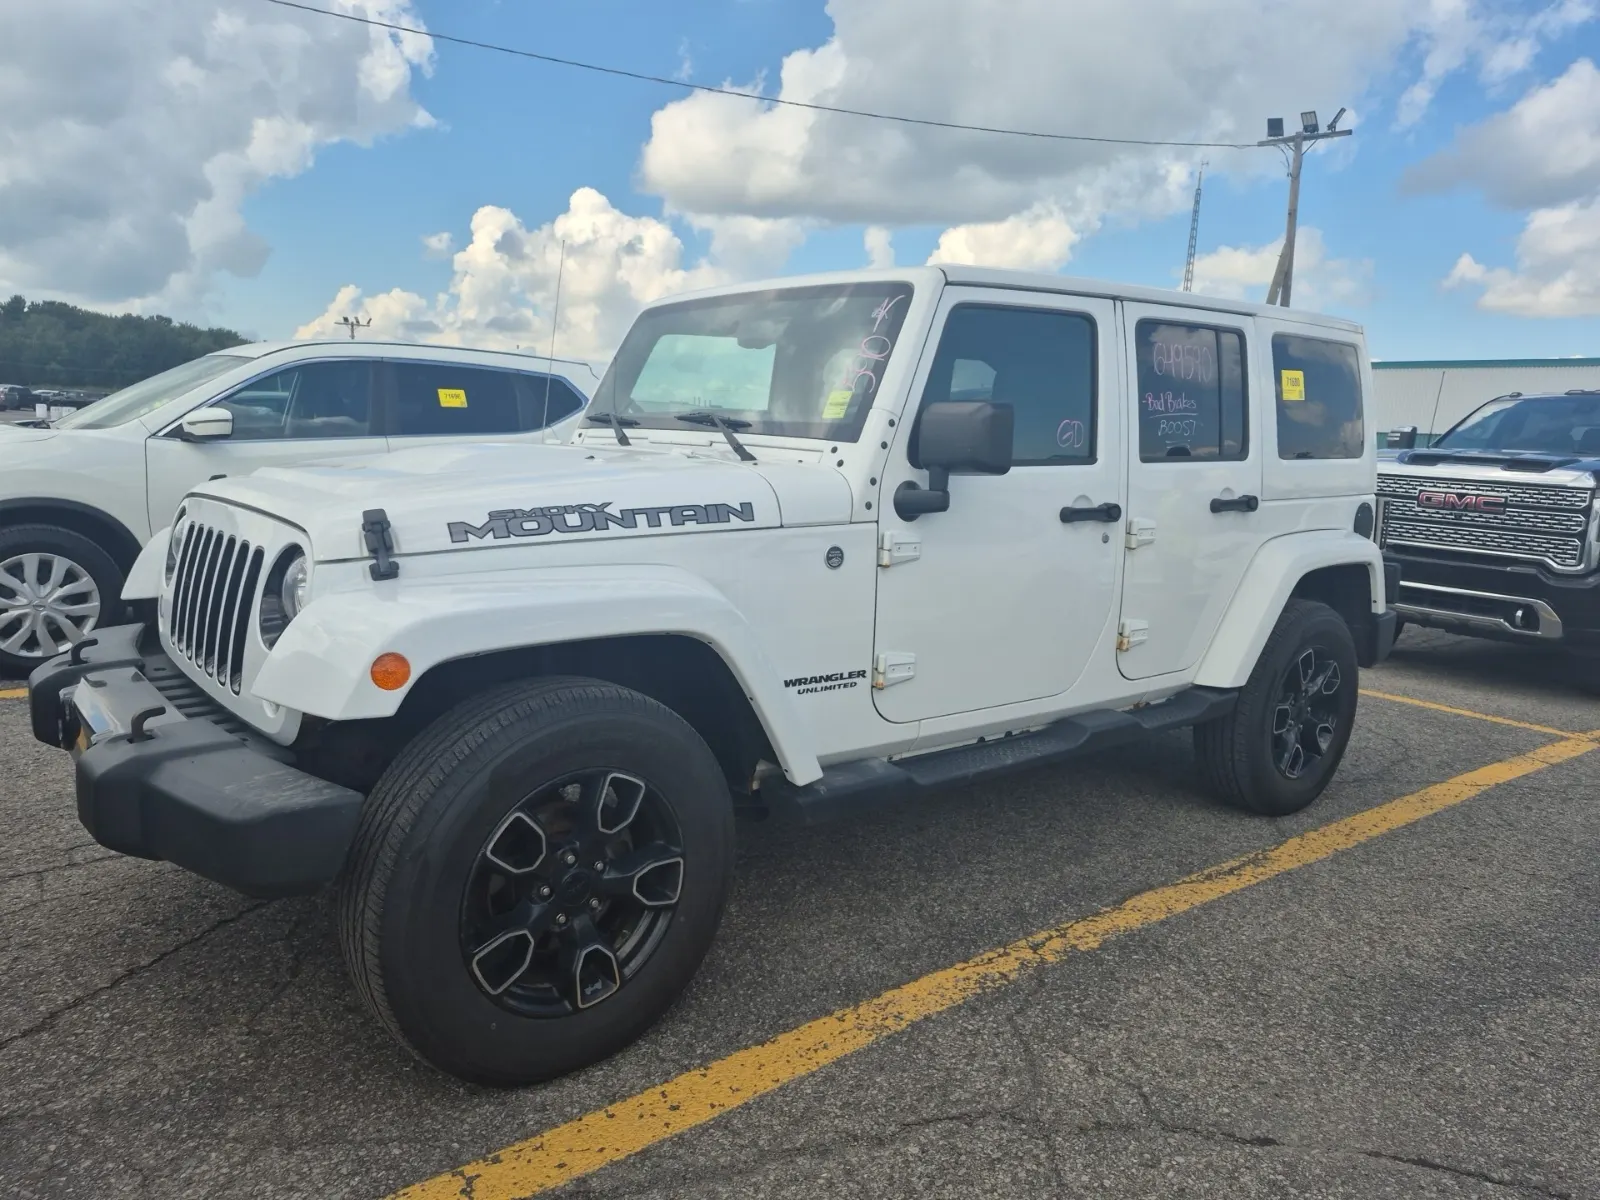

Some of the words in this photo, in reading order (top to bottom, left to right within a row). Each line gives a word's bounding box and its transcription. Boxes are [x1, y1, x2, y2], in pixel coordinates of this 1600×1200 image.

[488, 501, 613, 519] SMOKY
[1418, 491, 1506, 512] GMC
[447, 501, 755, 543] MOUNTAIN
[783, 669, 867, 688] WRANGLER
[797, 681, 858, 695] UNLIMITED
